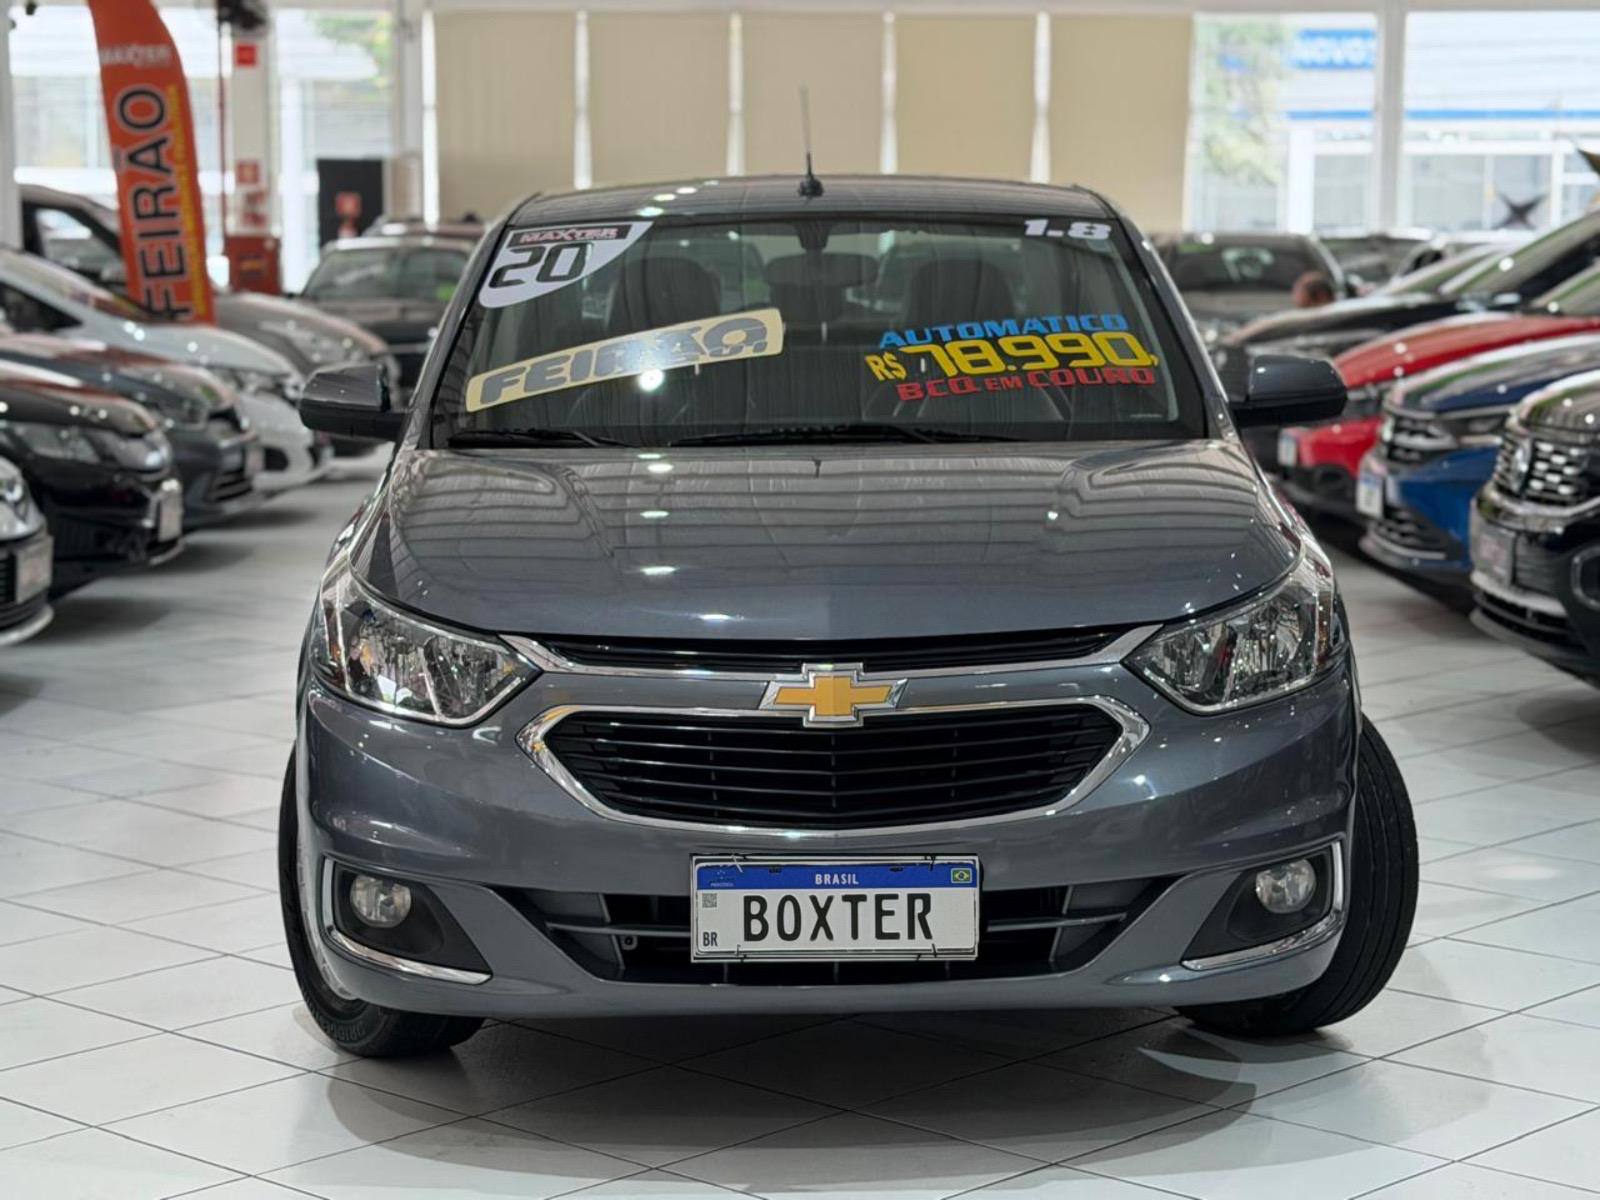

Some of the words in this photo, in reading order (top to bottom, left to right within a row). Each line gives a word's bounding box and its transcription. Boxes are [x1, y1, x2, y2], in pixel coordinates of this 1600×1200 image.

[1024, 219, 1111, 240] 1.8
[489, 243, 592, 288] 20
[865, 352, 907, 381] R$
[985, 375, 1023, 392] EM
[1027, 367, 1156, 388] COURO
[814, 873, 860, 885] BRASIL
[743, 893, 933, 942] BOXTER
[702, 932, 718, 947] BR
